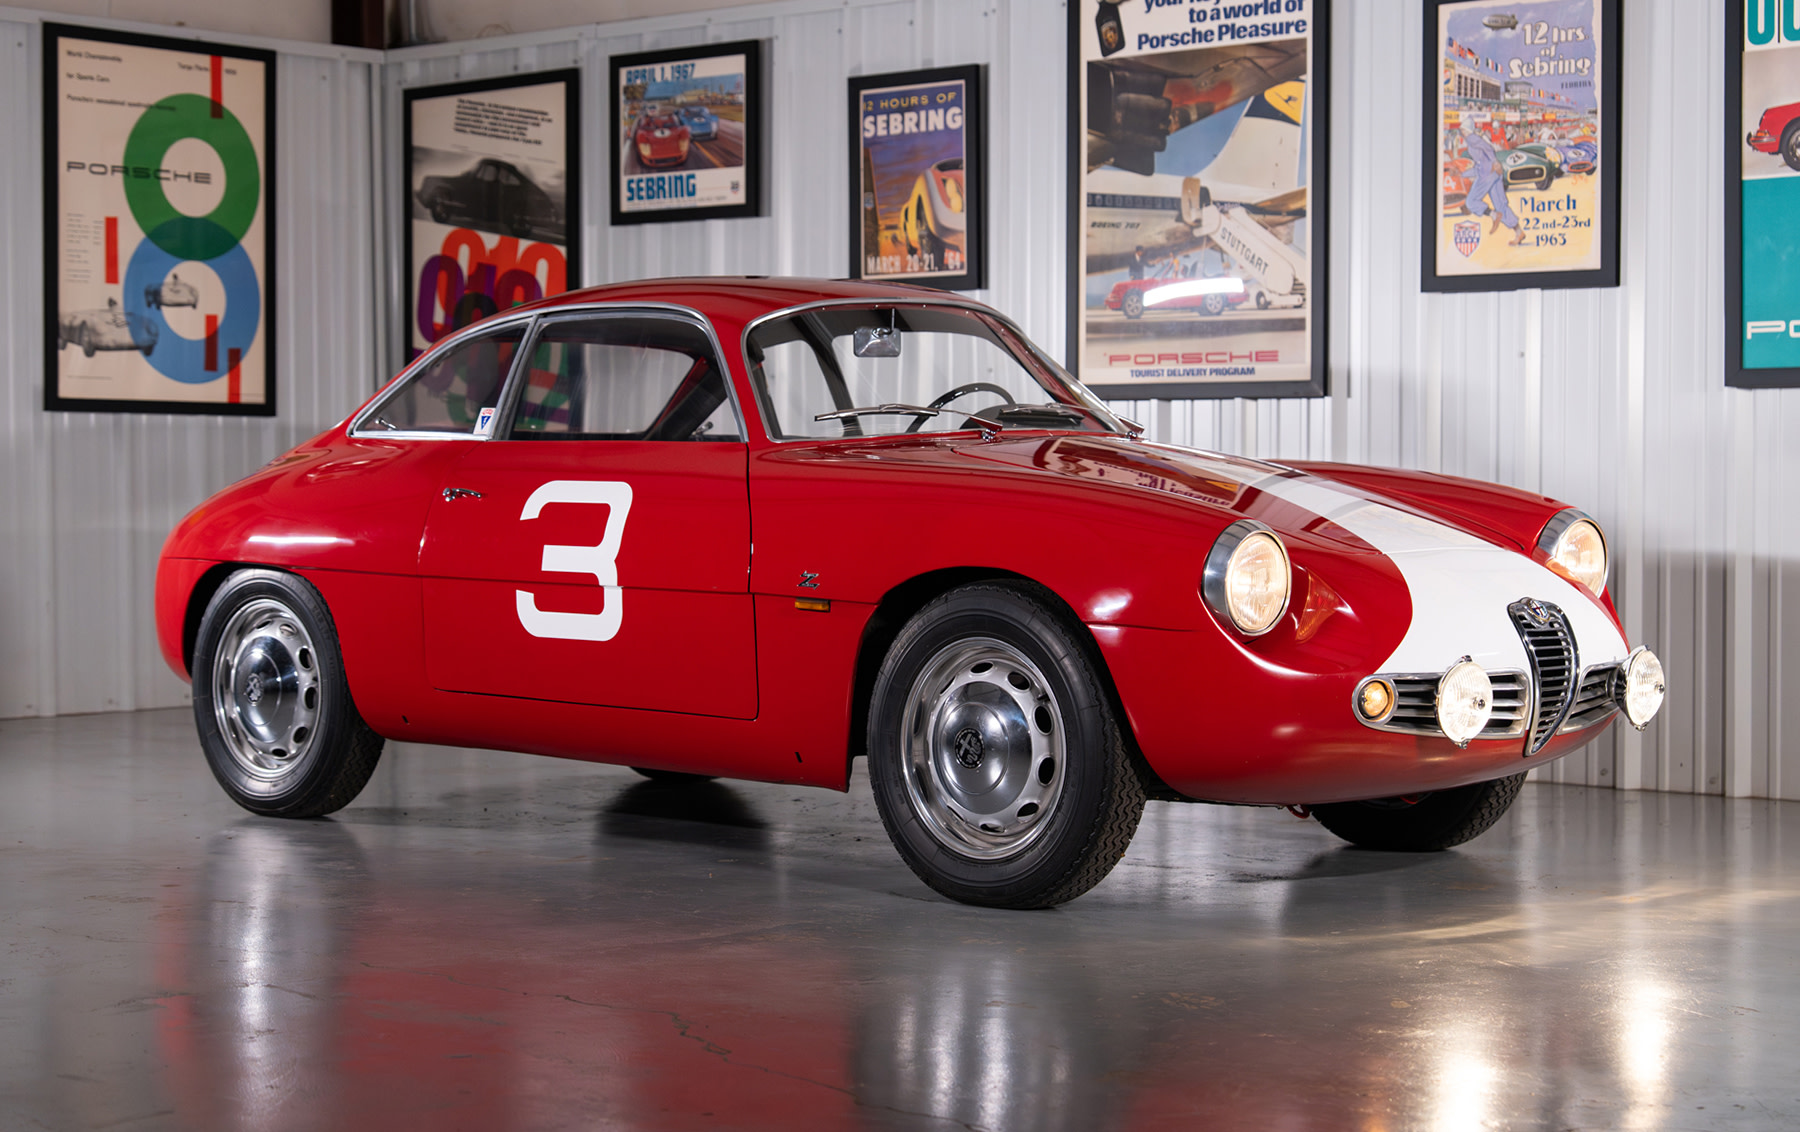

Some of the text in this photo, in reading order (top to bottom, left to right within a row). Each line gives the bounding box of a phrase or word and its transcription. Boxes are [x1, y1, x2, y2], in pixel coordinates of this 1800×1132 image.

[1189, 7, 1207, 24] to
[1209, 7, 1221, 22] a
[1223, 0, 1281, 20] world
[1137, 19, 1307, 50] Porsche Pleasure
[1523, 21, 1549, 46] 12
[1509, 54, 1592, 79] Sebring
[880, 95, 928, 110] HOURS
[936, 92, 956, 104] OF
[863, 106, 962, 138] SEBRING
[66, 160, 213, 185] PORSCHE
[626, 173, 696, 202] SEBRING
[1520, 194, 1577, 213] March
[1220, 226, 1269, 276] STUTTGART
[1536, 233, 1567, 247] 1963
[866, 255, 901, 274] MARCH
[1109, 350, 1279, 366] PORSCHE
[1130, 367, 1255, 378] TOURIST DELIVERY PROGRAM
[516, 480, 633, 641] 3
[797, 570, 820, 591] Z
